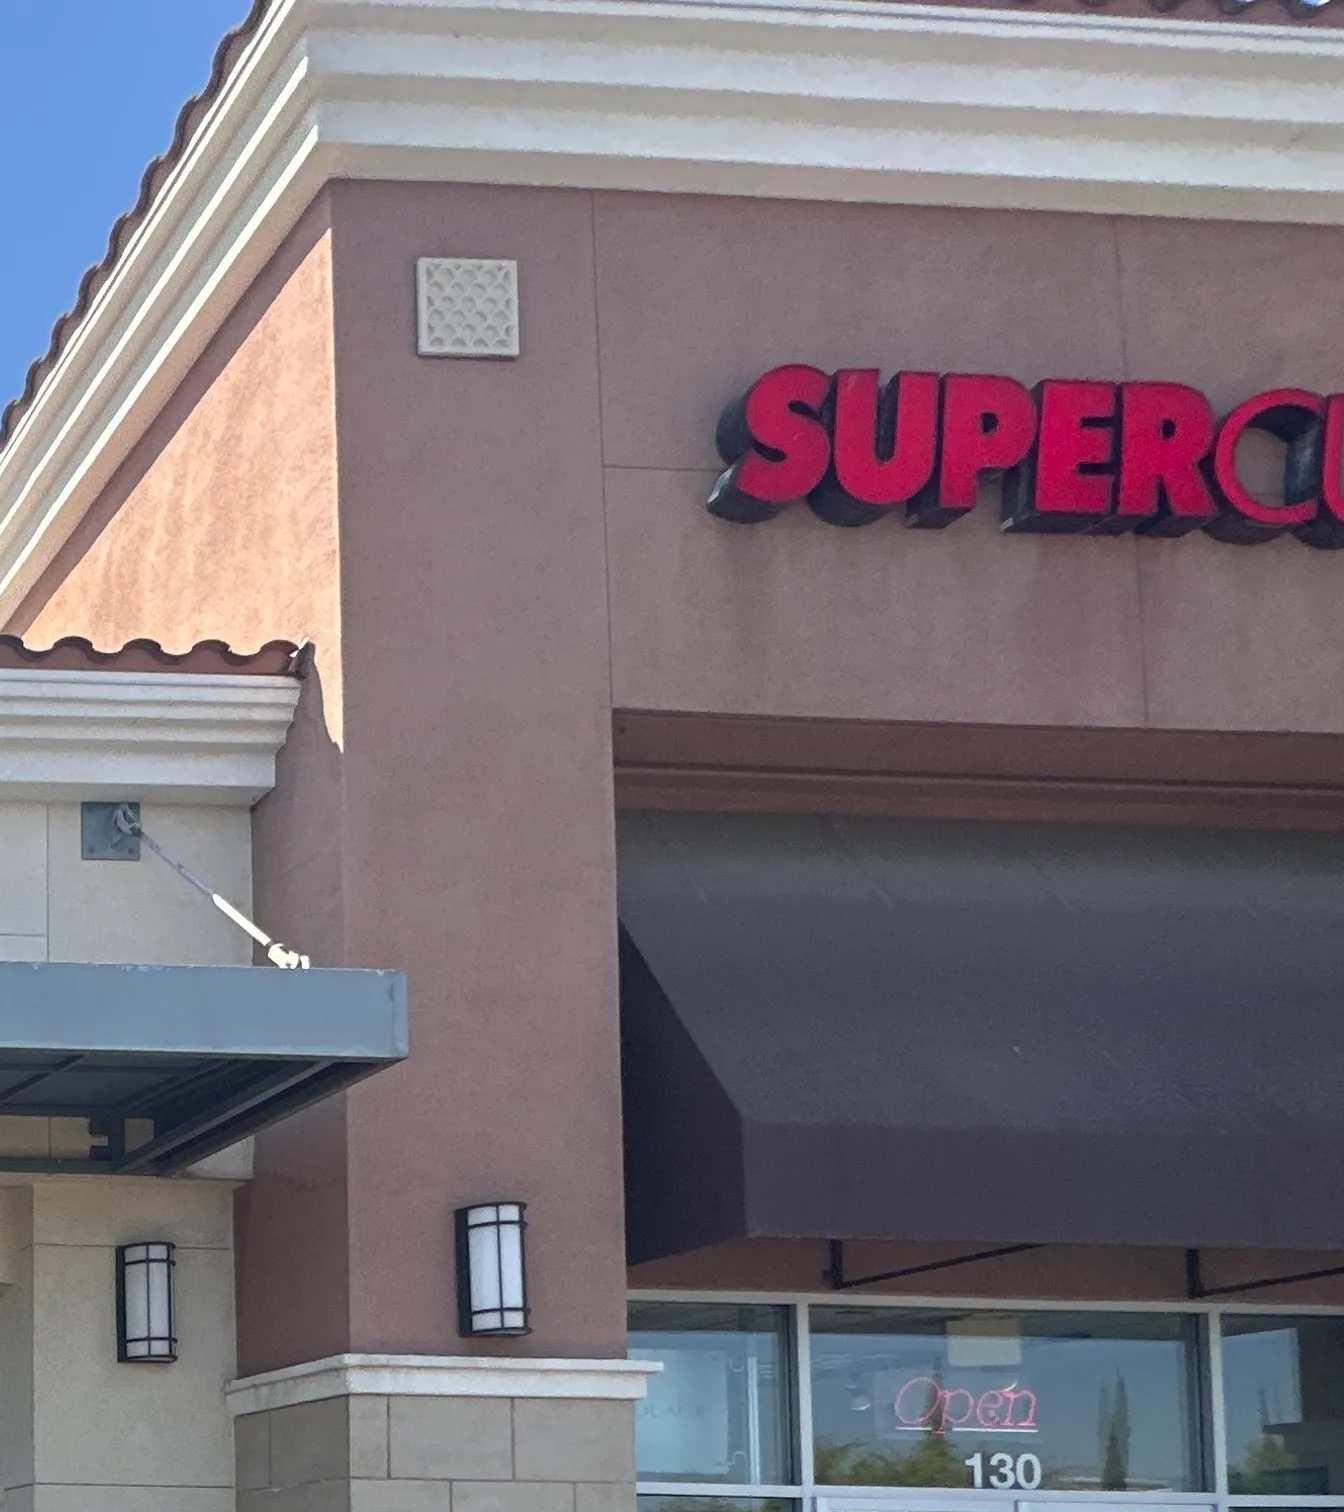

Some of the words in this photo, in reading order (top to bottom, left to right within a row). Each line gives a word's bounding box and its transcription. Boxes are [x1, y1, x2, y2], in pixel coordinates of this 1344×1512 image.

[727, 362, 1344, 528] SUPERC
[894, 1376, 1037, 1436] Open
[965, 1452, 1042, 1490] 130
